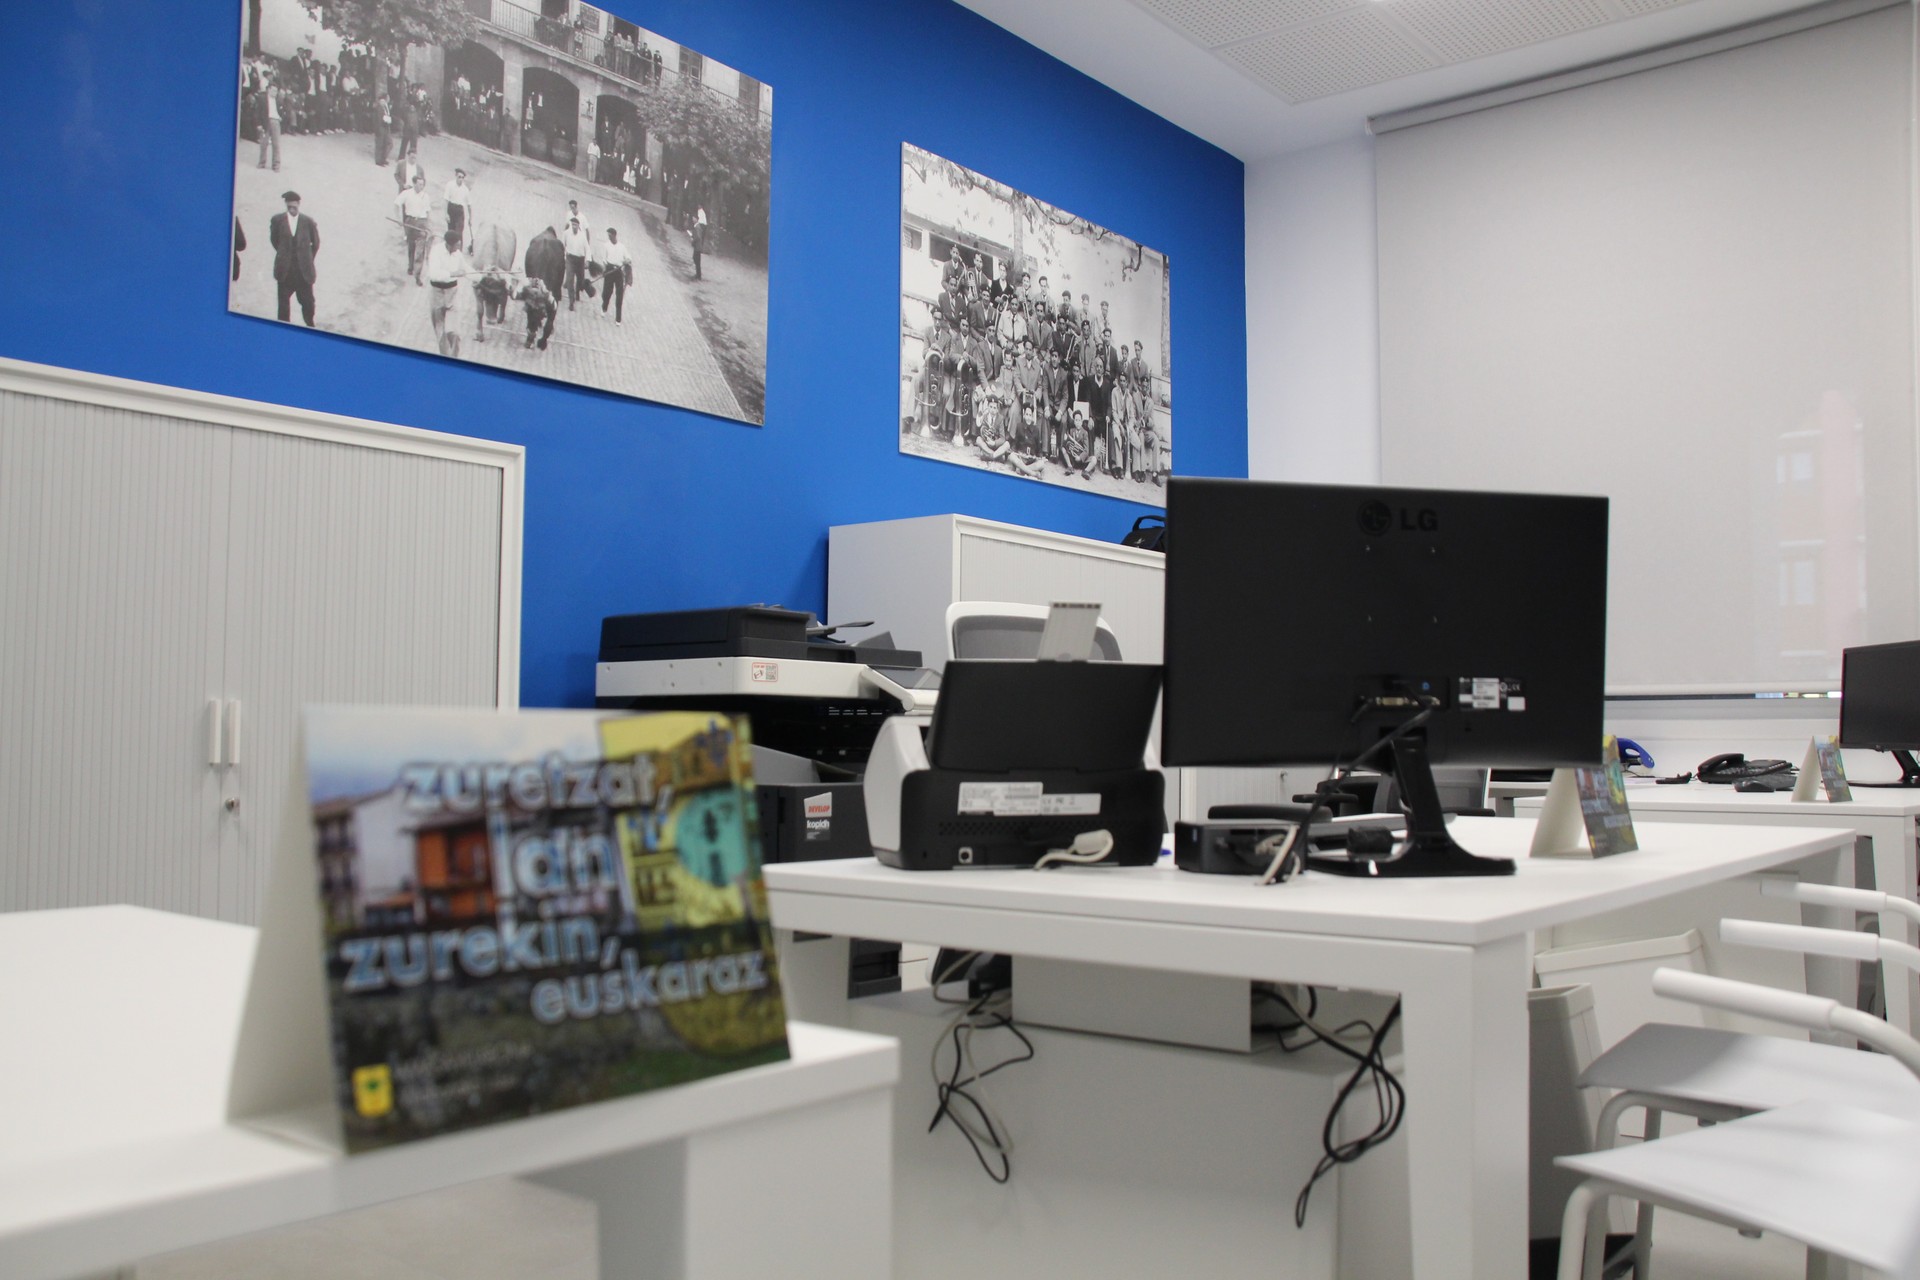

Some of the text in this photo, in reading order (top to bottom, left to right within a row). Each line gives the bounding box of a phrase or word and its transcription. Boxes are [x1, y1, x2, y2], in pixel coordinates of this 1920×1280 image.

[1400, 508, 1439, 532] LG
[808, 805, 831, 813] DEVELOP
[340, 902, 620, 993] zurekin,
[530, 949, 768, 1024] euskaraz
